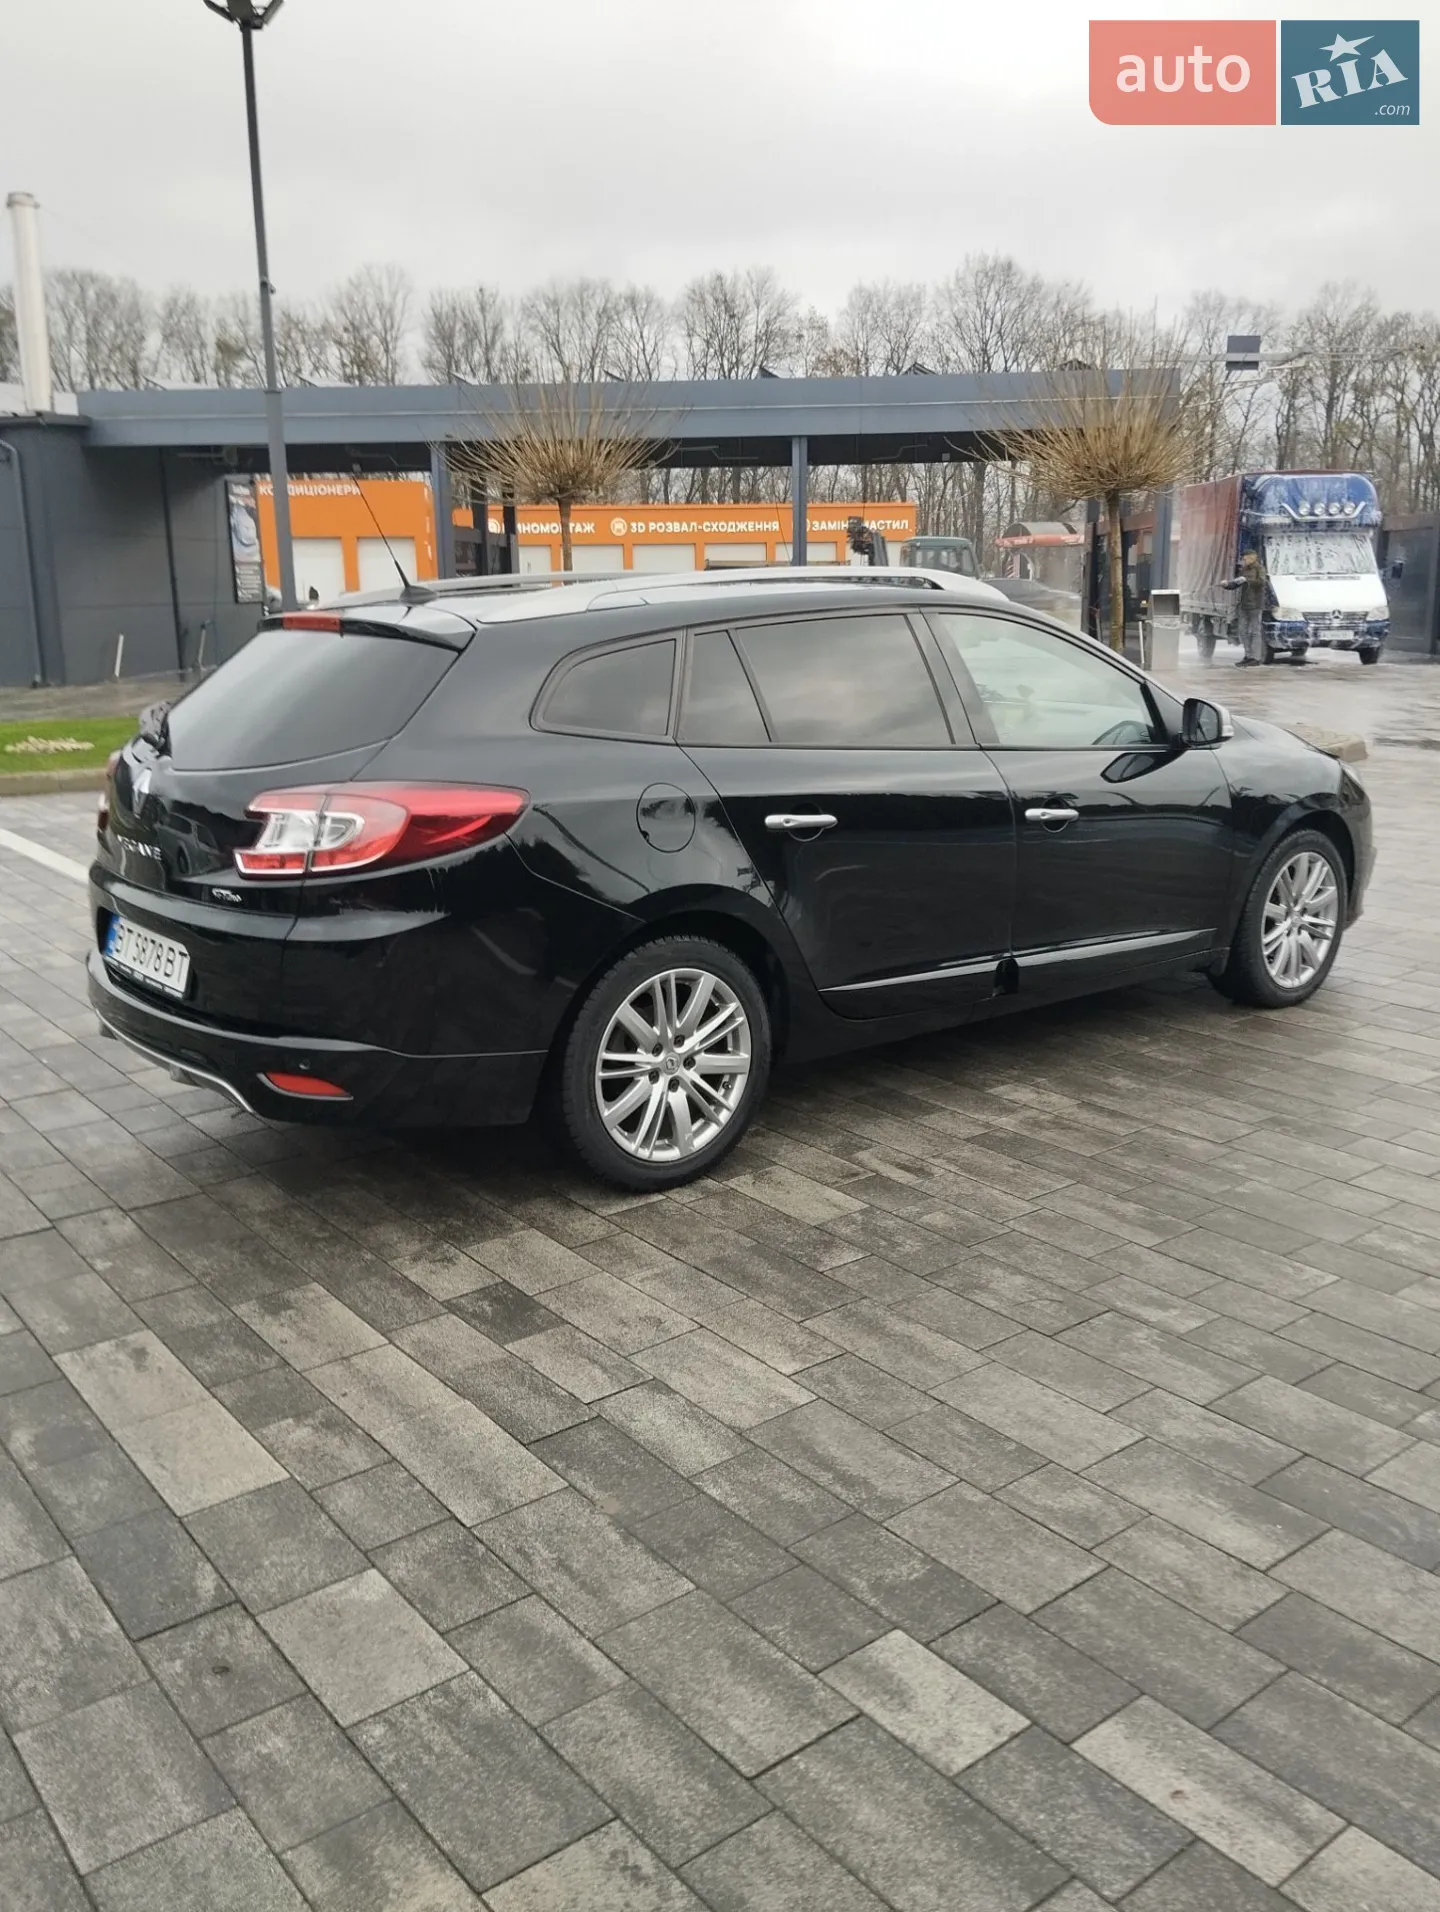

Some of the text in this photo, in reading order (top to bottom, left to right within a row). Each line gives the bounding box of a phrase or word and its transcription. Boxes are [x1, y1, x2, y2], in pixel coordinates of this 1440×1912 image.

[260, 483, 361, 496] КОДИЦІОНЕРИ
[502, 521, 596, 534] ИНОМОТАЖ
[631, 520, 780, 533] 3D РОЗВАЛ-СХОДЖЕННЯ
[811, 520, 849, 531] ЗАМІН
